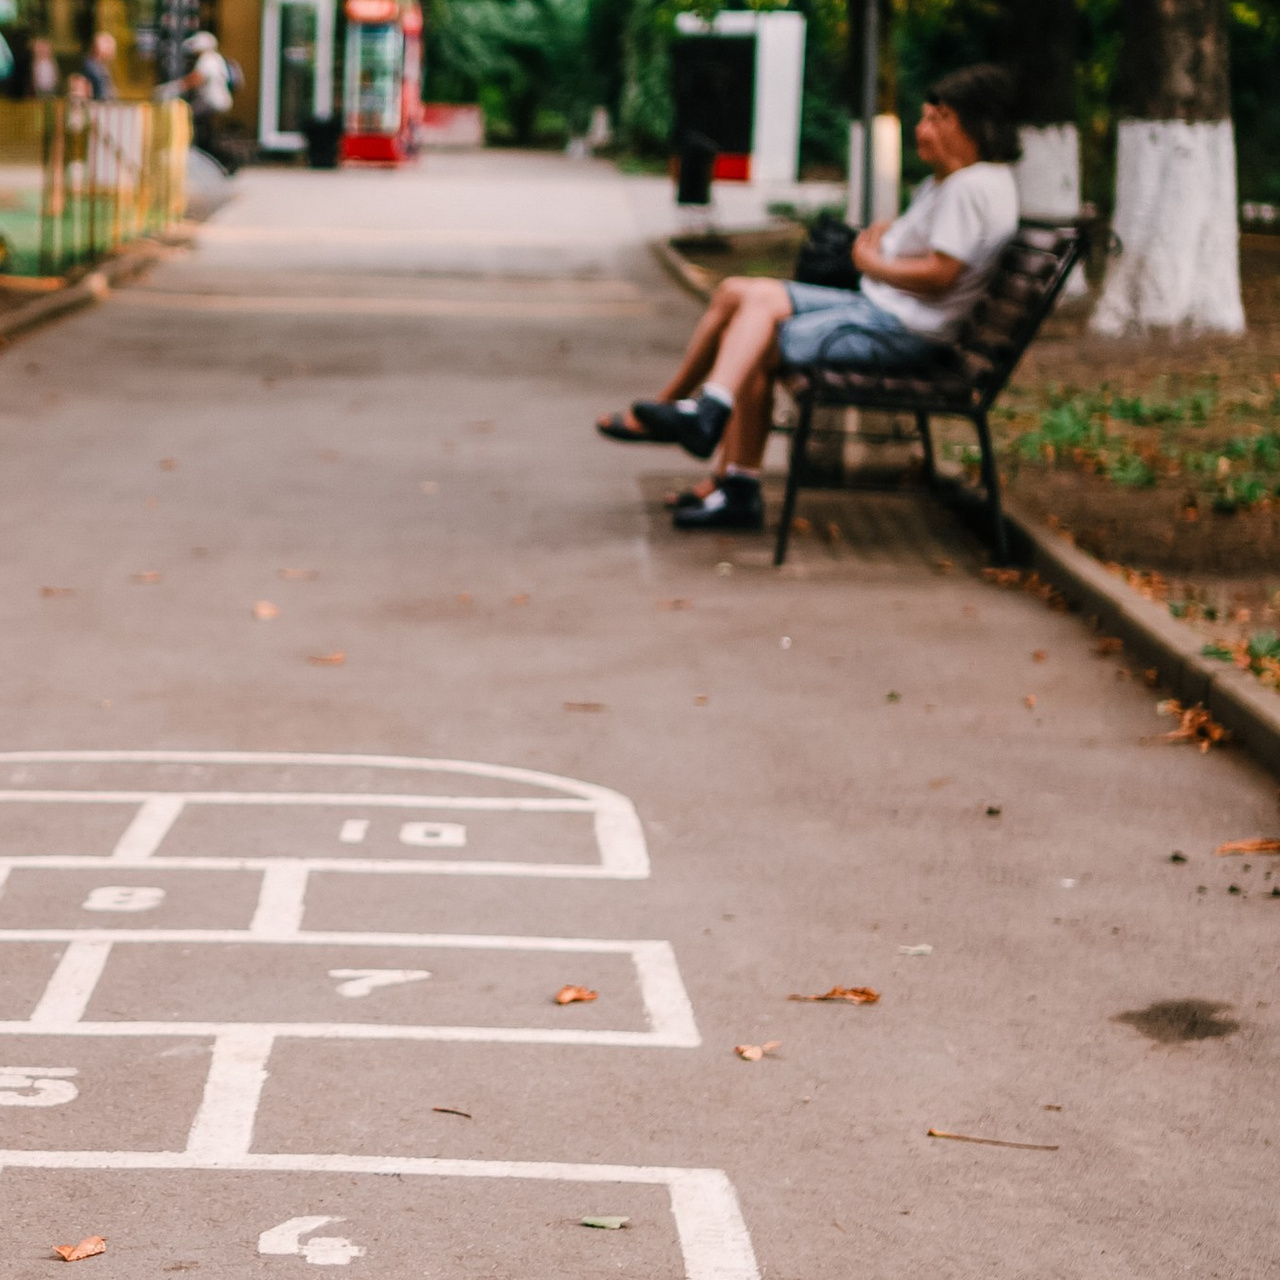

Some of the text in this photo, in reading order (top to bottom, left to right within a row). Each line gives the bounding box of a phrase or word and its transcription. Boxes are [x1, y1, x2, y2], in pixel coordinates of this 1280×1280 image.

[339, 819, 466, 847] 10
[82, 886, 165, 912] 8
[329, 968, 430, 998] 7
[257, 1215, 366, 1266] 4
